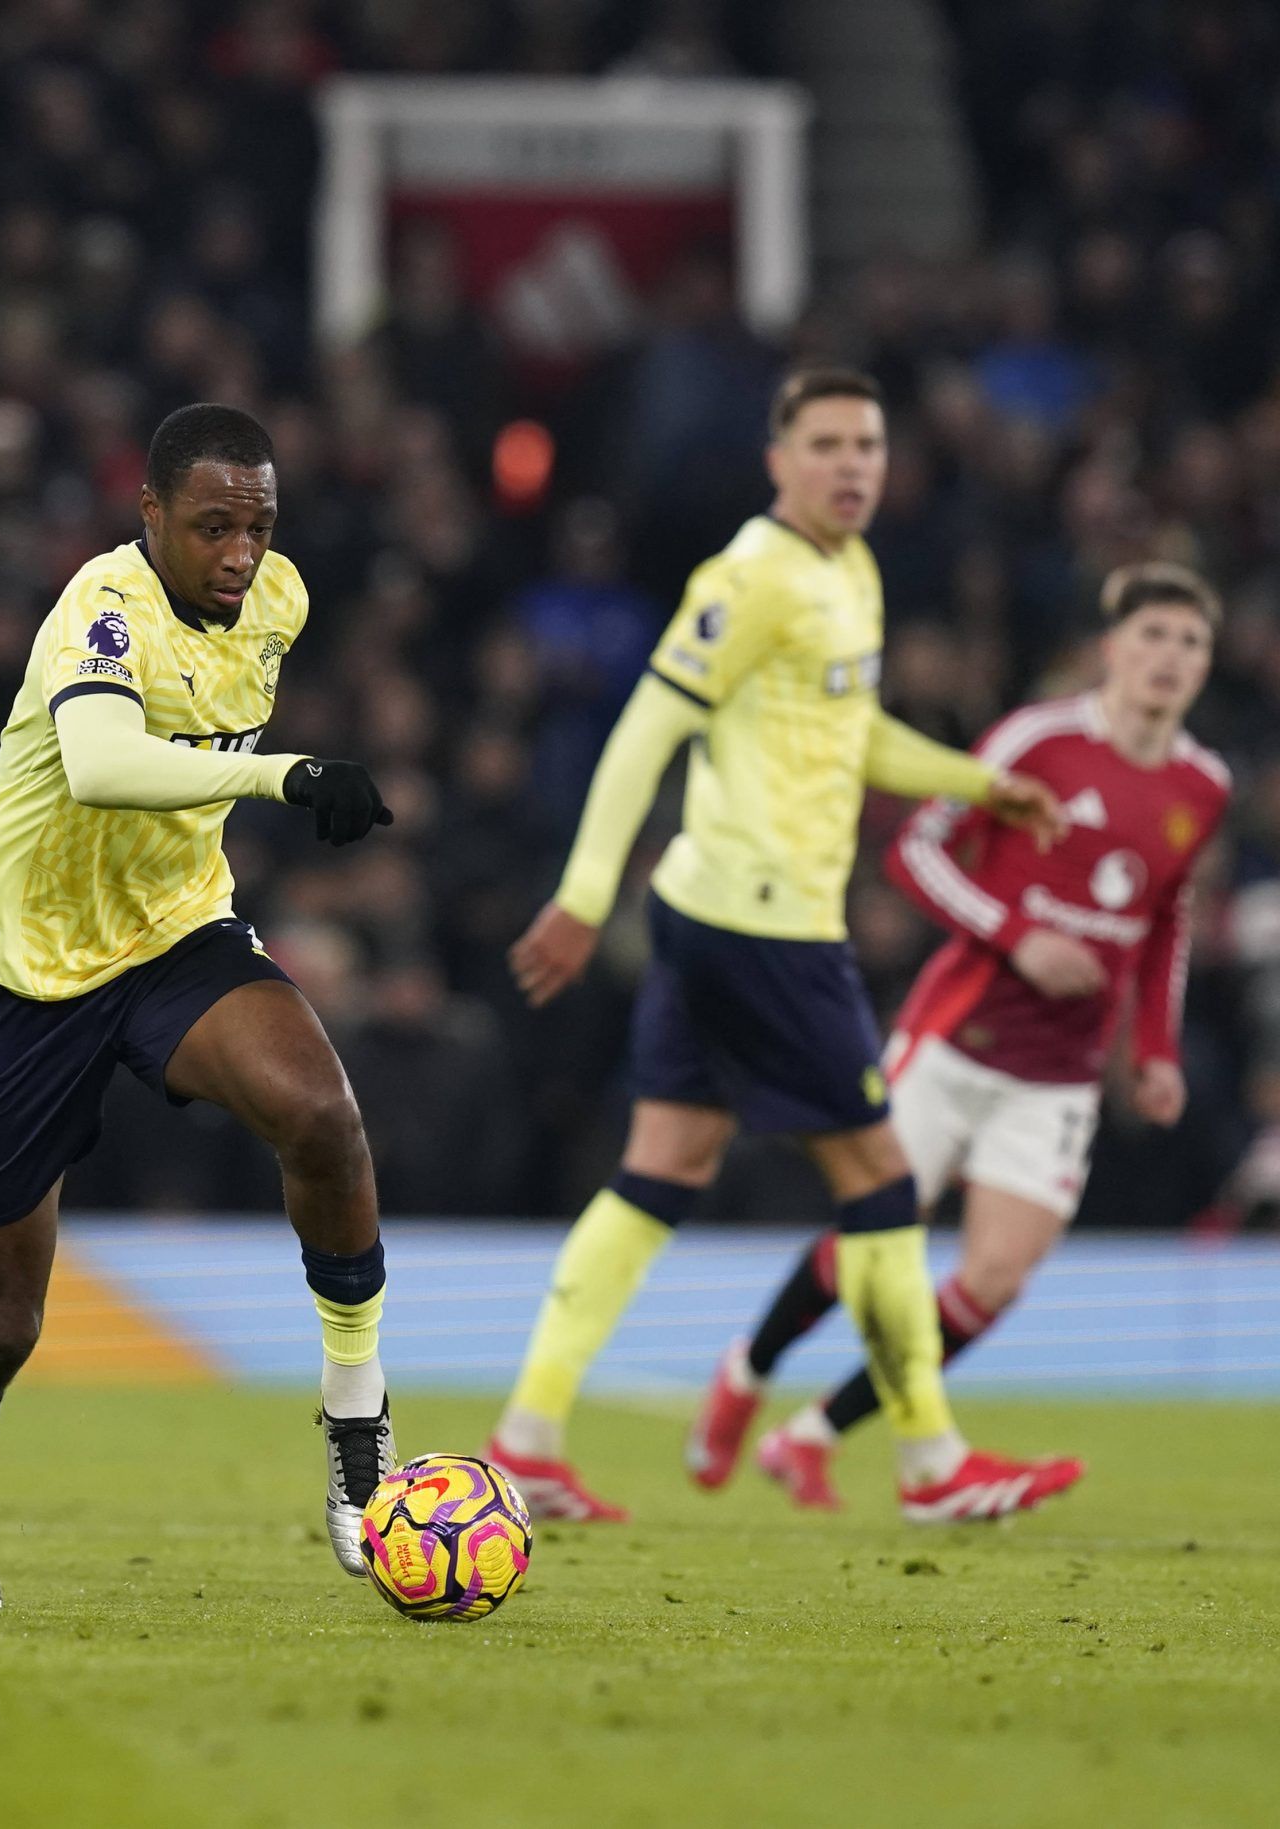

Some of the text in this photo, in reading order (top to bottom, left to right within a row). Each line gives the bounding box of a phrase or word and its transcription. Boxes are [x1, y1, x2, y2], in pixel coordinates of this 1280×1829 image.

[79, 659, 129, 676] No room
[396, 1545, 411, 1579] FLIGHT
[402, 1543, 414, 1567] NIKE
